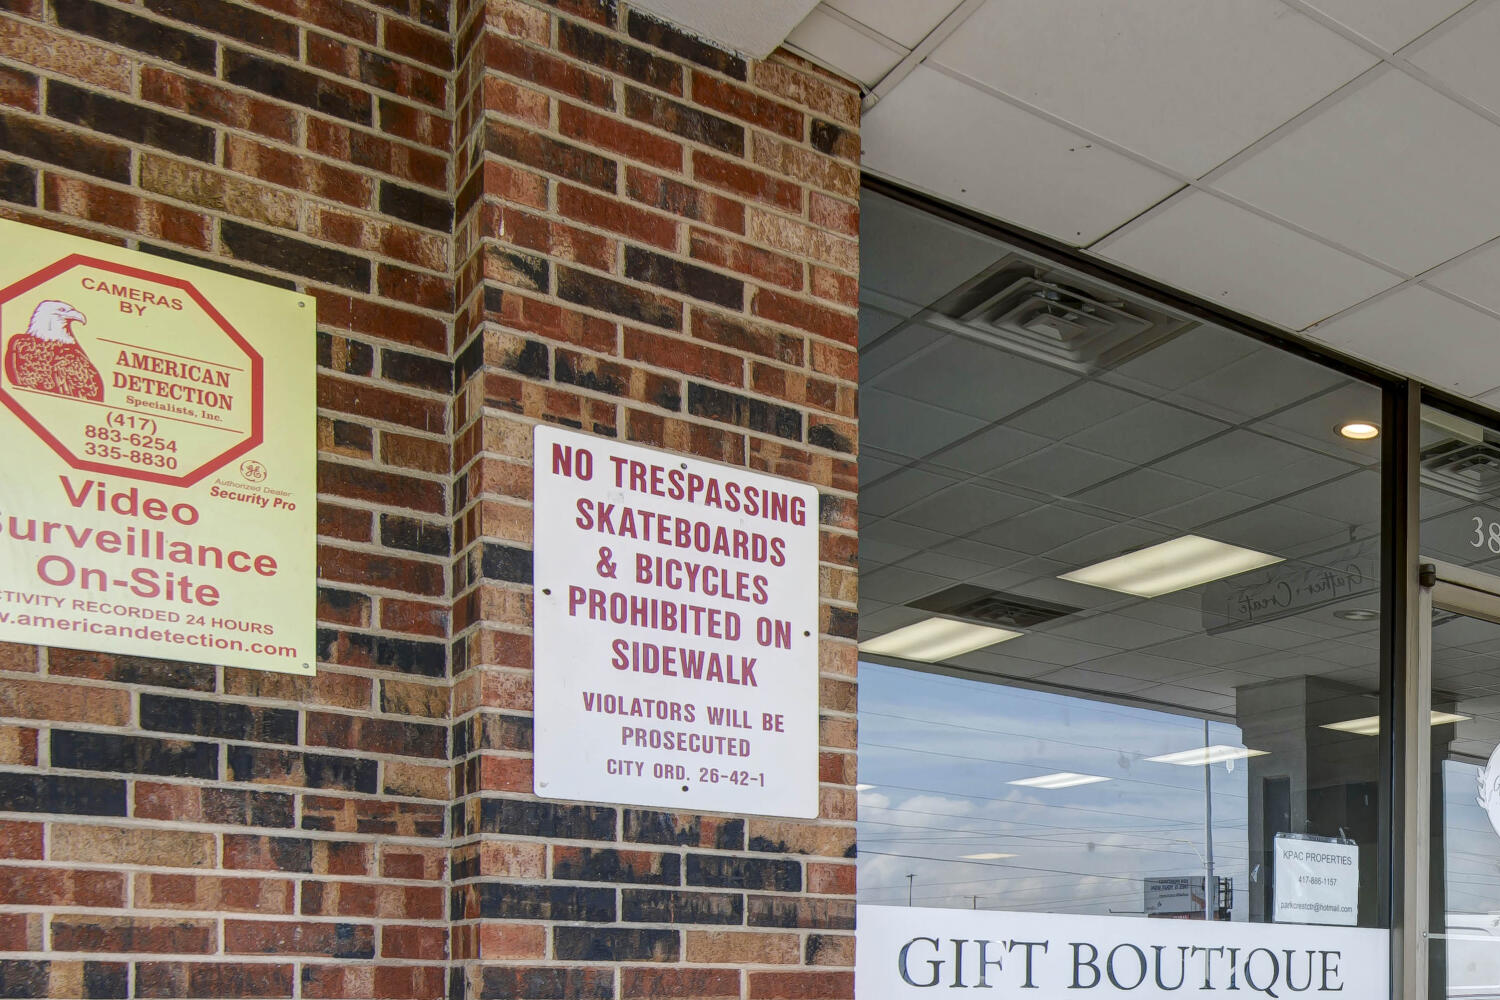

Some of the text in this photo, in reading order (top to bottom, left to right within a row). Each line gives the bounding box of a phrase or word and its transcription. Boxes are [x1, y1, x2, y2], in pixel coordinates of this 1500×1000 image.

[81, 276, 184, 311] CAMERAS
[119, 299, 147, 317] BY
[115, 350, 231, 389] AMERICAN
[112, 371, 234, 412] DETECTION
[126, 395, 224, 423] Specialists, Inc.
[84, 424, 178, 453] 883-6254
[106, 411, 158, 435] (417)
[84, 441, 178, 470] 335-8830
[59, 475, 200, 526] Video
[210, 486, 296, 511] Security Pro
[214, 478, 292, 497] Authorized Dealer
[552, 442, 806, 527] NO TRESPASSING
[0, 510, 278, 577] urveillance
[575, 497, 786, 567] SKATEBOARDS
[37, 554, 221, 608] On-Site
[596, 546, 769, 605] & BICYCLES
[0, 589, 66, 609] TIVITY
[72, 598, 274, 636] RECORDED 24 HOURS
[569, 585, 792, 650] PROHIBITED ON
[611, 638, 758, 688] SIDEWALK
[582, 692, 785, 733] VIOLATORS WILL BE
[621, 726, 751, 757] PROSECUTED
[607, 759, 765, 787] CITY ORD. 26-42-1
[1283, 850, 1352, 866] KPAC PROPERTIES
[899, 936, 1345, 998] GIFT BOUTIQUE
